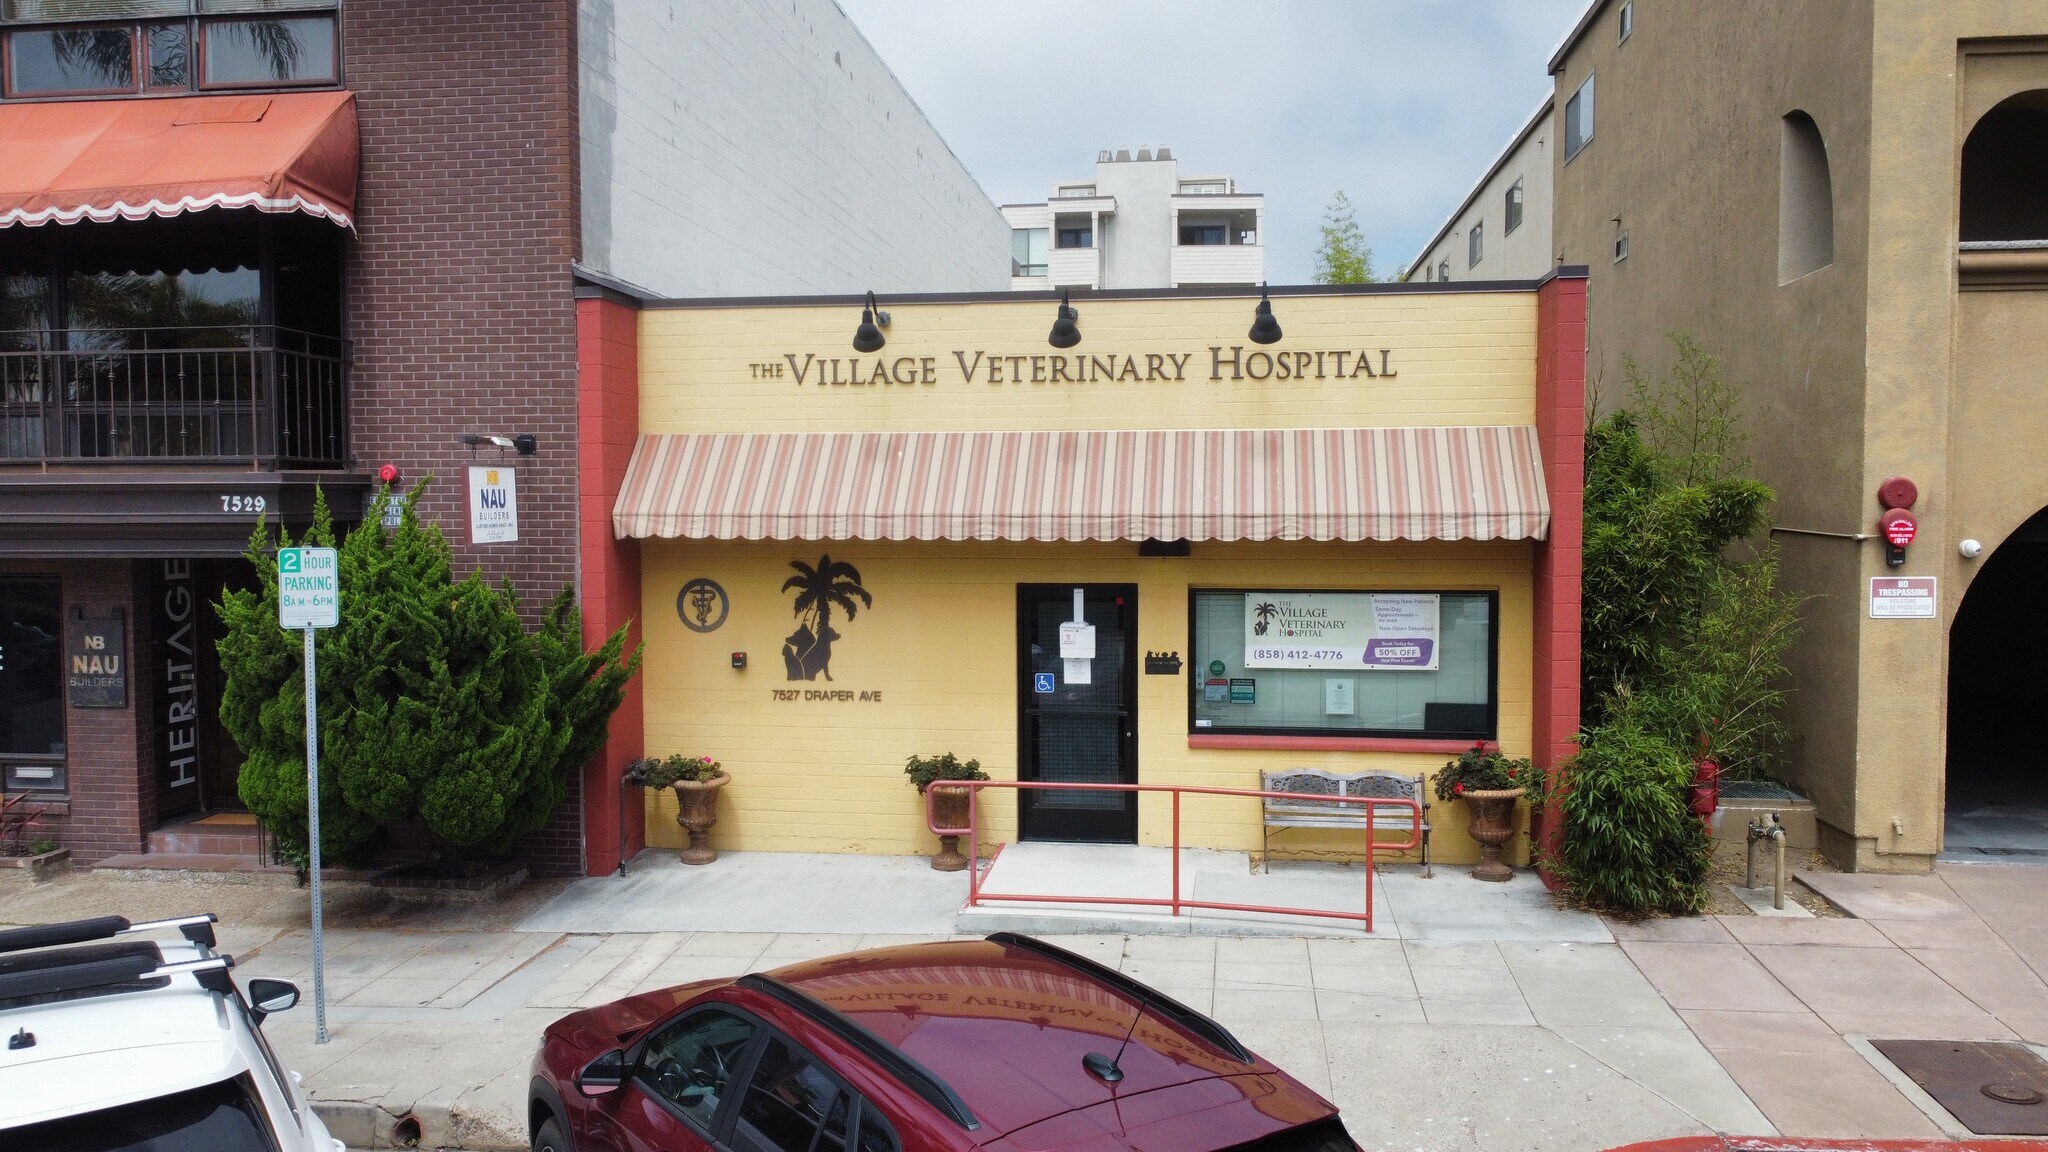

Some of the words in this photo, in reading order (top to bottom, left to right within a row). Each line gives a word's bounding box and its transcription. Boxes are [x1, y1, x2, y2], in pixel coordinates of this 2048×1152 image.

[749, 363, 783, 378] THE
[784, 353, 937, 386] VILLAGE
[952, 350, 1192, 384] VETERINARY
[1208, 346, 1397, 380] HOSPITAL
[221, 496, 265, 512] 7529
[481, 488, 506, 508] NAU
[479, 511, 510, 520] BUILDERS
[284, 552, 297, 570] 2
[304, 556, 332, 569] HOUR
[284, 576, 332, 591] PARKING
[1898, 580, 1909, 588] NO
[1878, 588, 1929, 597] TRESPASSING
[1279, 607, 1328, 618] VILLAGE
[1279, 619, 1347, 629] VETERINARY
[1253, 649, 1284, 660] (858)
[1287, 650, 1343, 660] 412-4776
[73, 655, 119, 674] NAU
[165, 559, 196, 788] HERITAGE
[70, 677, 124, 687] BUILDERS
[772, 689, 800, 701] 7527
[804, 690, 854, 702] DRAPER
[859, 690, 882, 702] AVE
